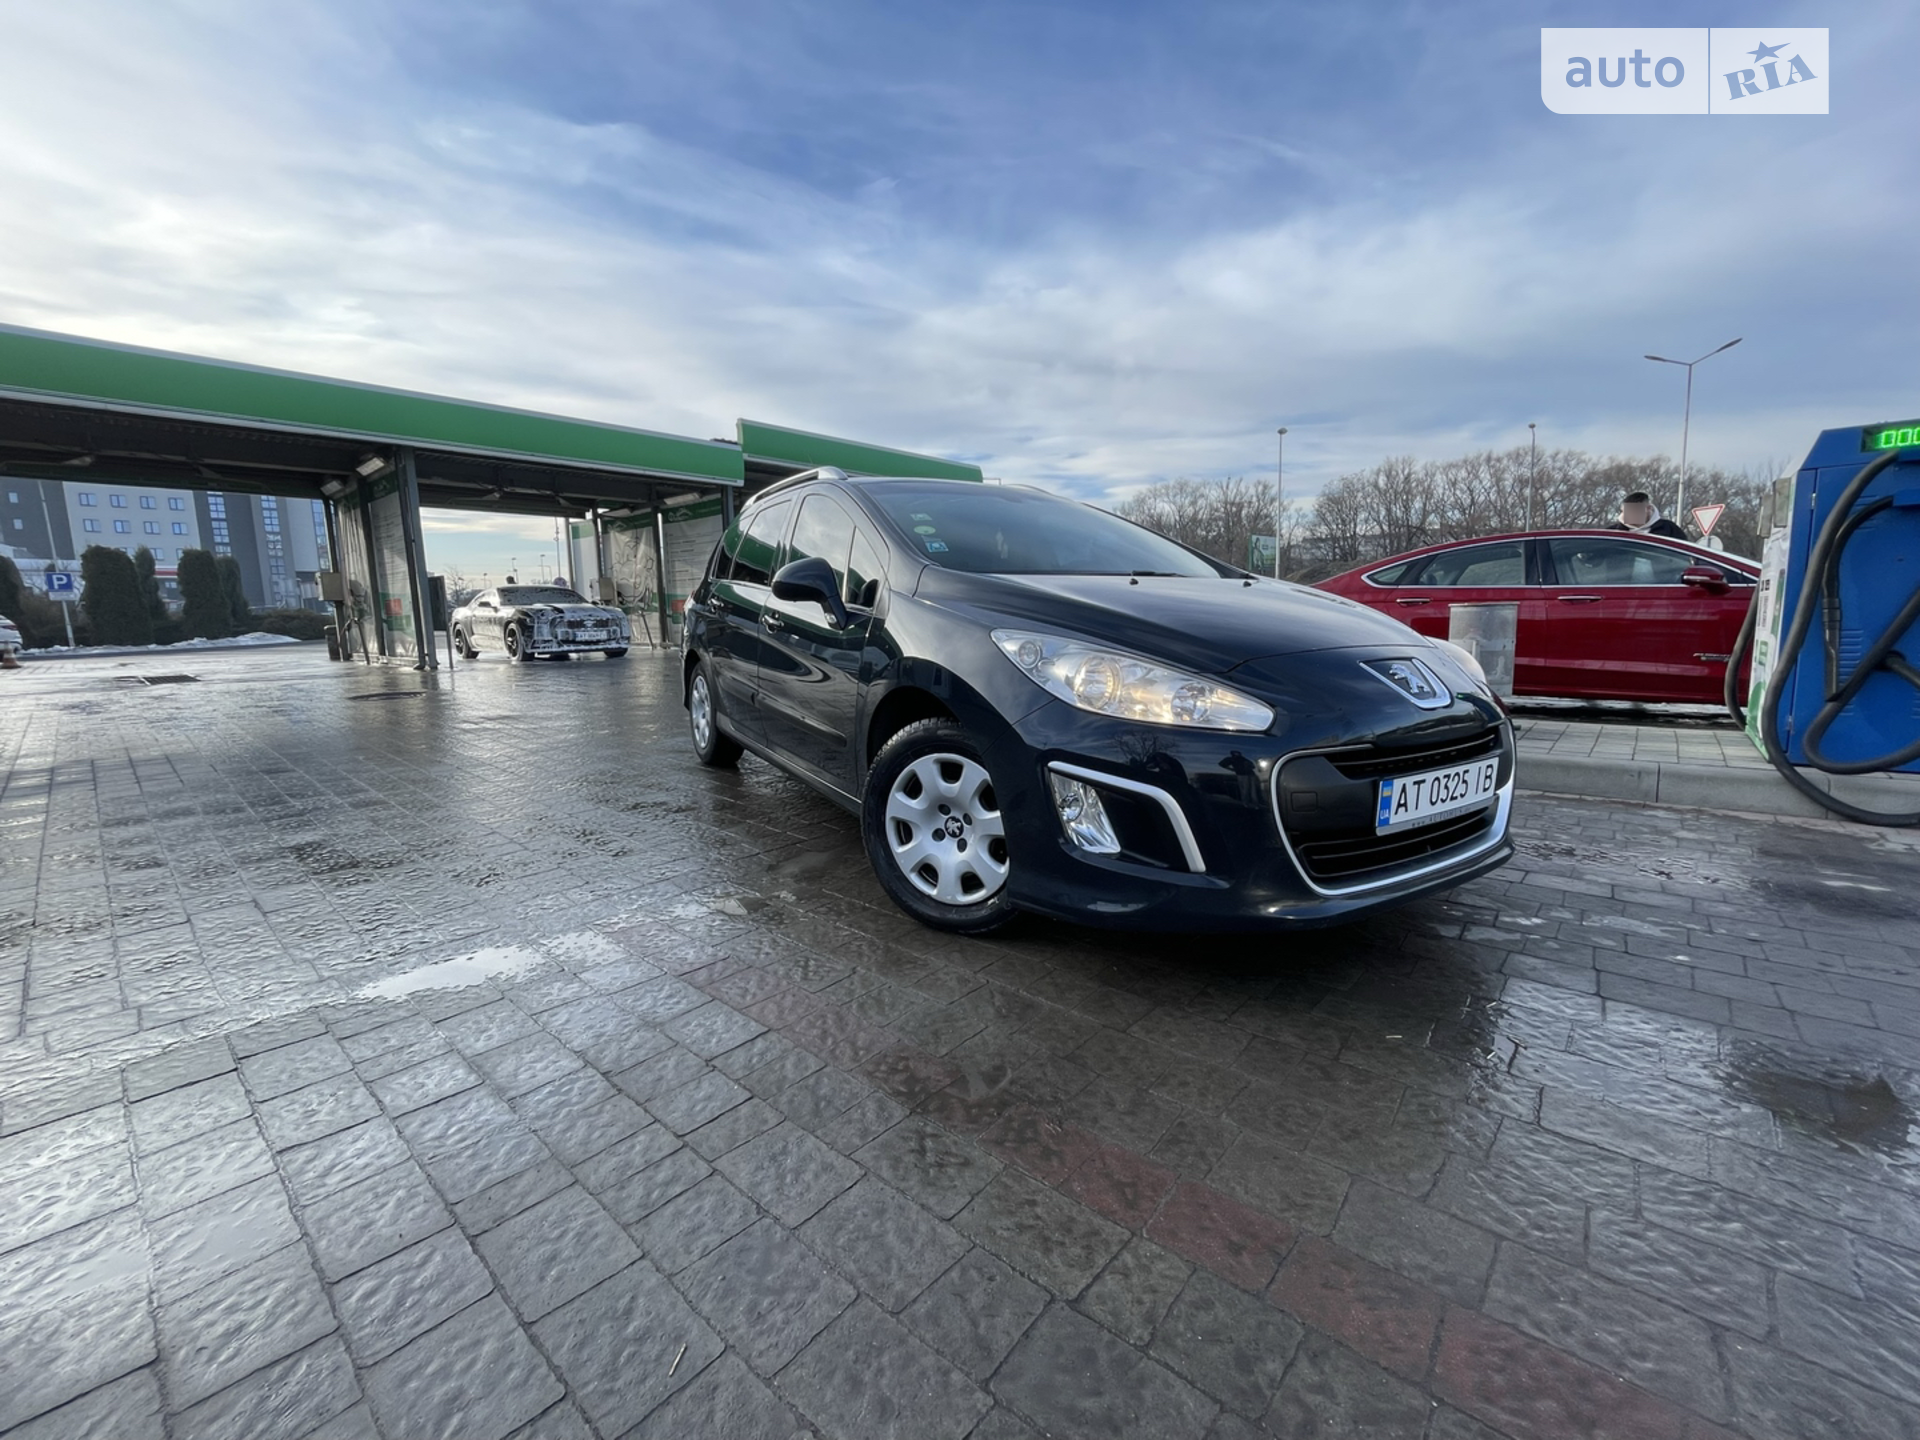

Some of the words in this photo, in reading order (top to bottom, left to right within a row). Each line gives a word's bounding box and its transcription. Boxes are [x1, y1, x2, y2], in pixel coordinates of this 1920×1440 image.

[52, 574, 68, 589] P
[1394, 779, 1426, 815] AT
[1429, 769, 1470, 806] 0325
[1475, 763, 1494, 795] IB
